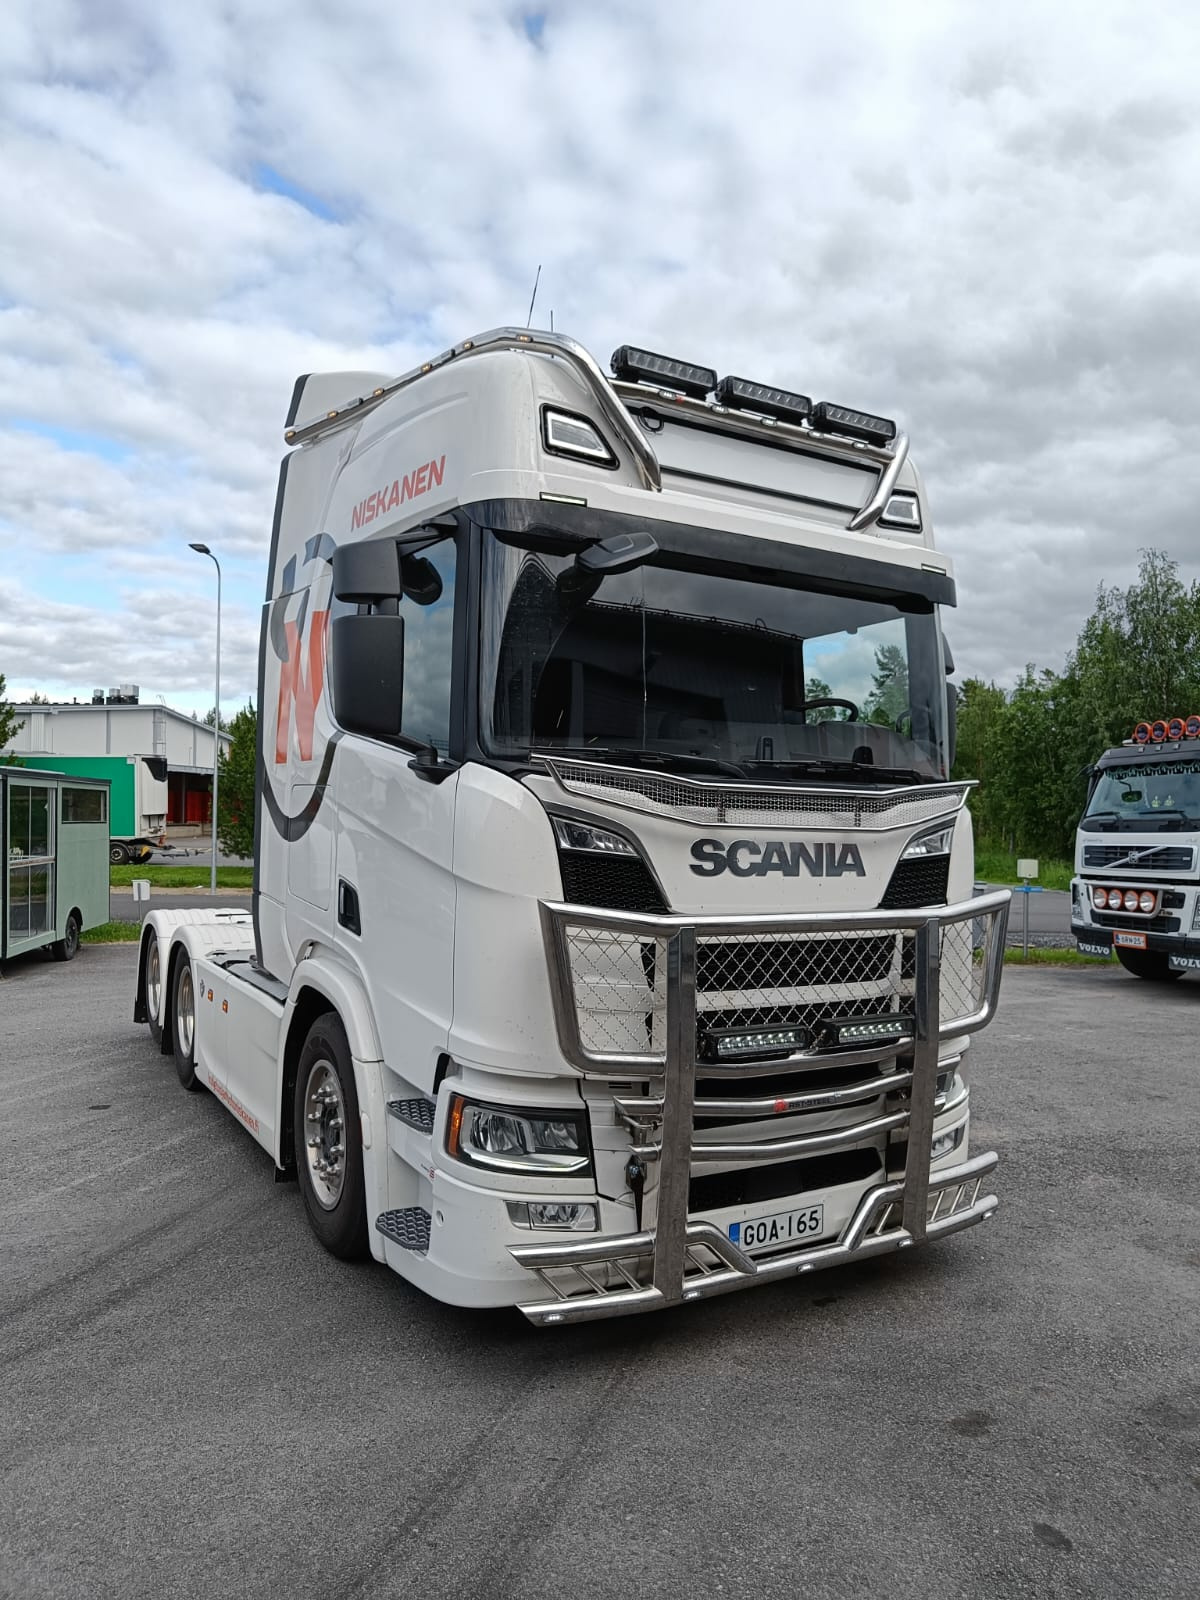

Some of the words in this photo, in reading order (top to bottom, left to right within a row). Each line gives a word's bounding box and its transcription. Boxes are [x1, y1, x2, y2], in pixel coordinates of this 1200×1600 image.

[351, 455, 446, 533] NISKANEN
[689, 838, 867, 877] SCANIA
[1079, 943, 1110, 955] VOLVO
[744, 1210, 819, 1246] GOA-165
